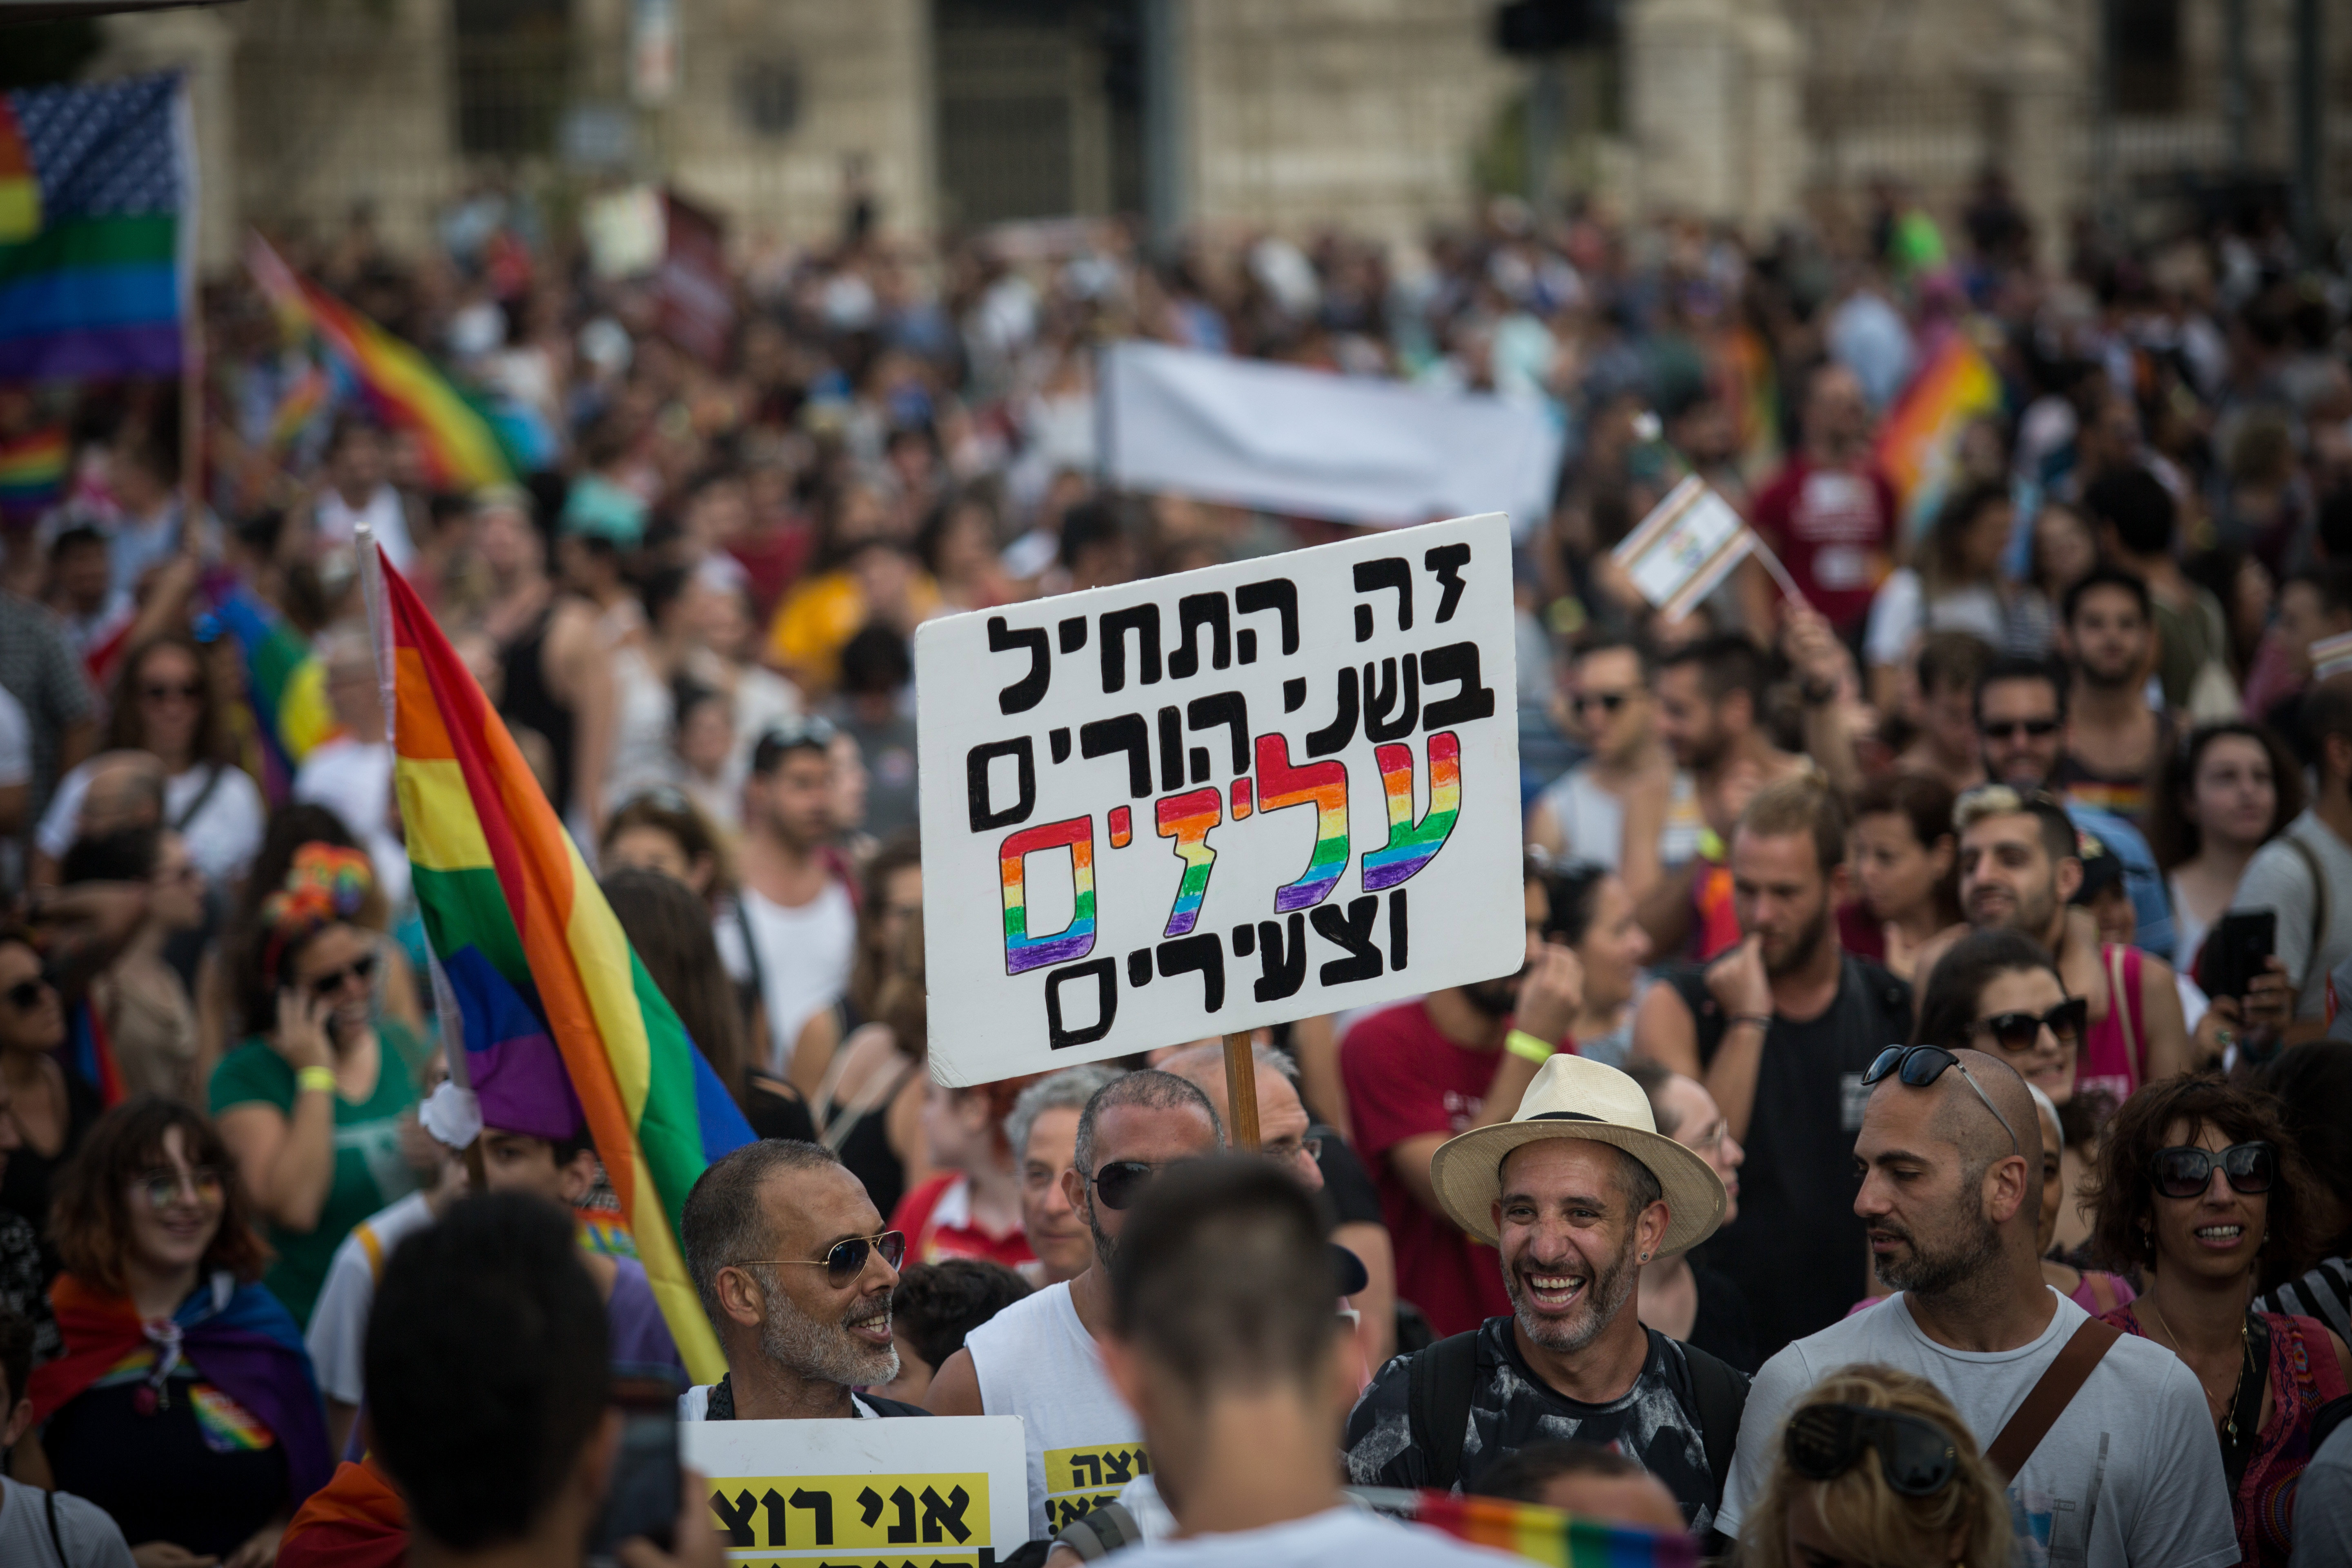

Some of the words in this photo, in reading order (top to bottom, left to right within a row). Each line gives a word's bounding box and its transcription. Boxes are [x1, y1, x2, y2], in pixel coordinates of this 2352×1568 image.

[987, 577, 1300, 715] התחיל
[1353, 542, 1471, 644] זה
[1282, 641, 1495, 759] בשני
[966, 690, 1252, 834] הורים
[998, 730, 1462, 976] עליזים
[1045, 888, 1408, 1051] וצעירים
[707, 1487, 834, 1547] רוצ
[856, 1484, 972, 1545] אני
[1069, 1448, 1149, 1488] וצה
